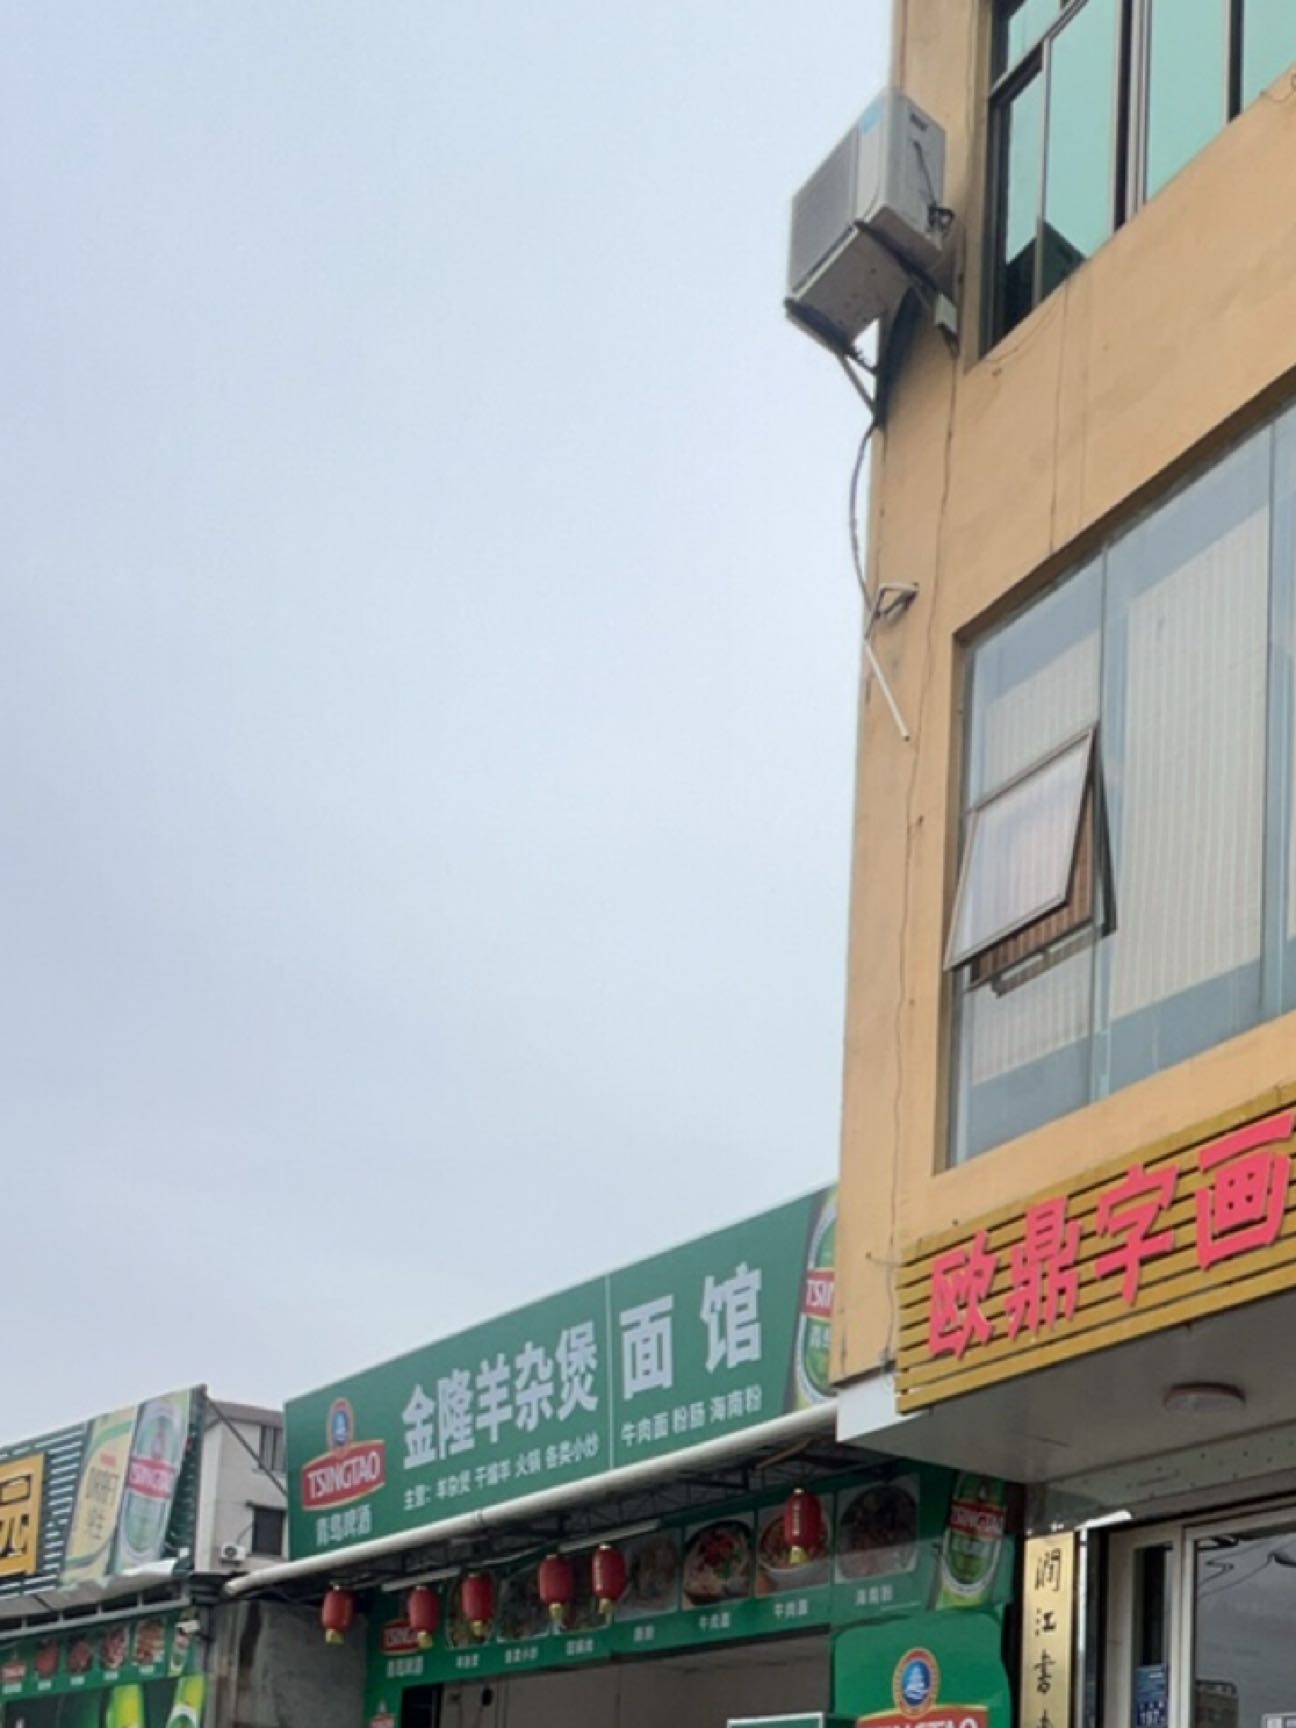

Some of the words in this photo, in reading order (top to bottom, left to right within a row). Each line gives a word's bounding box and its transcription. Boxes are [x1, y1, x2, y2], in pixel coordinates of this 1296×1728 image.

[402, 1319, 599, 1470] 金隆羊杂煲
[619, 1262, 763, 1400] 面馆
[620, 1411, 669, 1447] 牛肉面
[307, 1450, 382, 1500] TSINGTAO
[315, 1503, 373, 1547] 青岛啤酒
